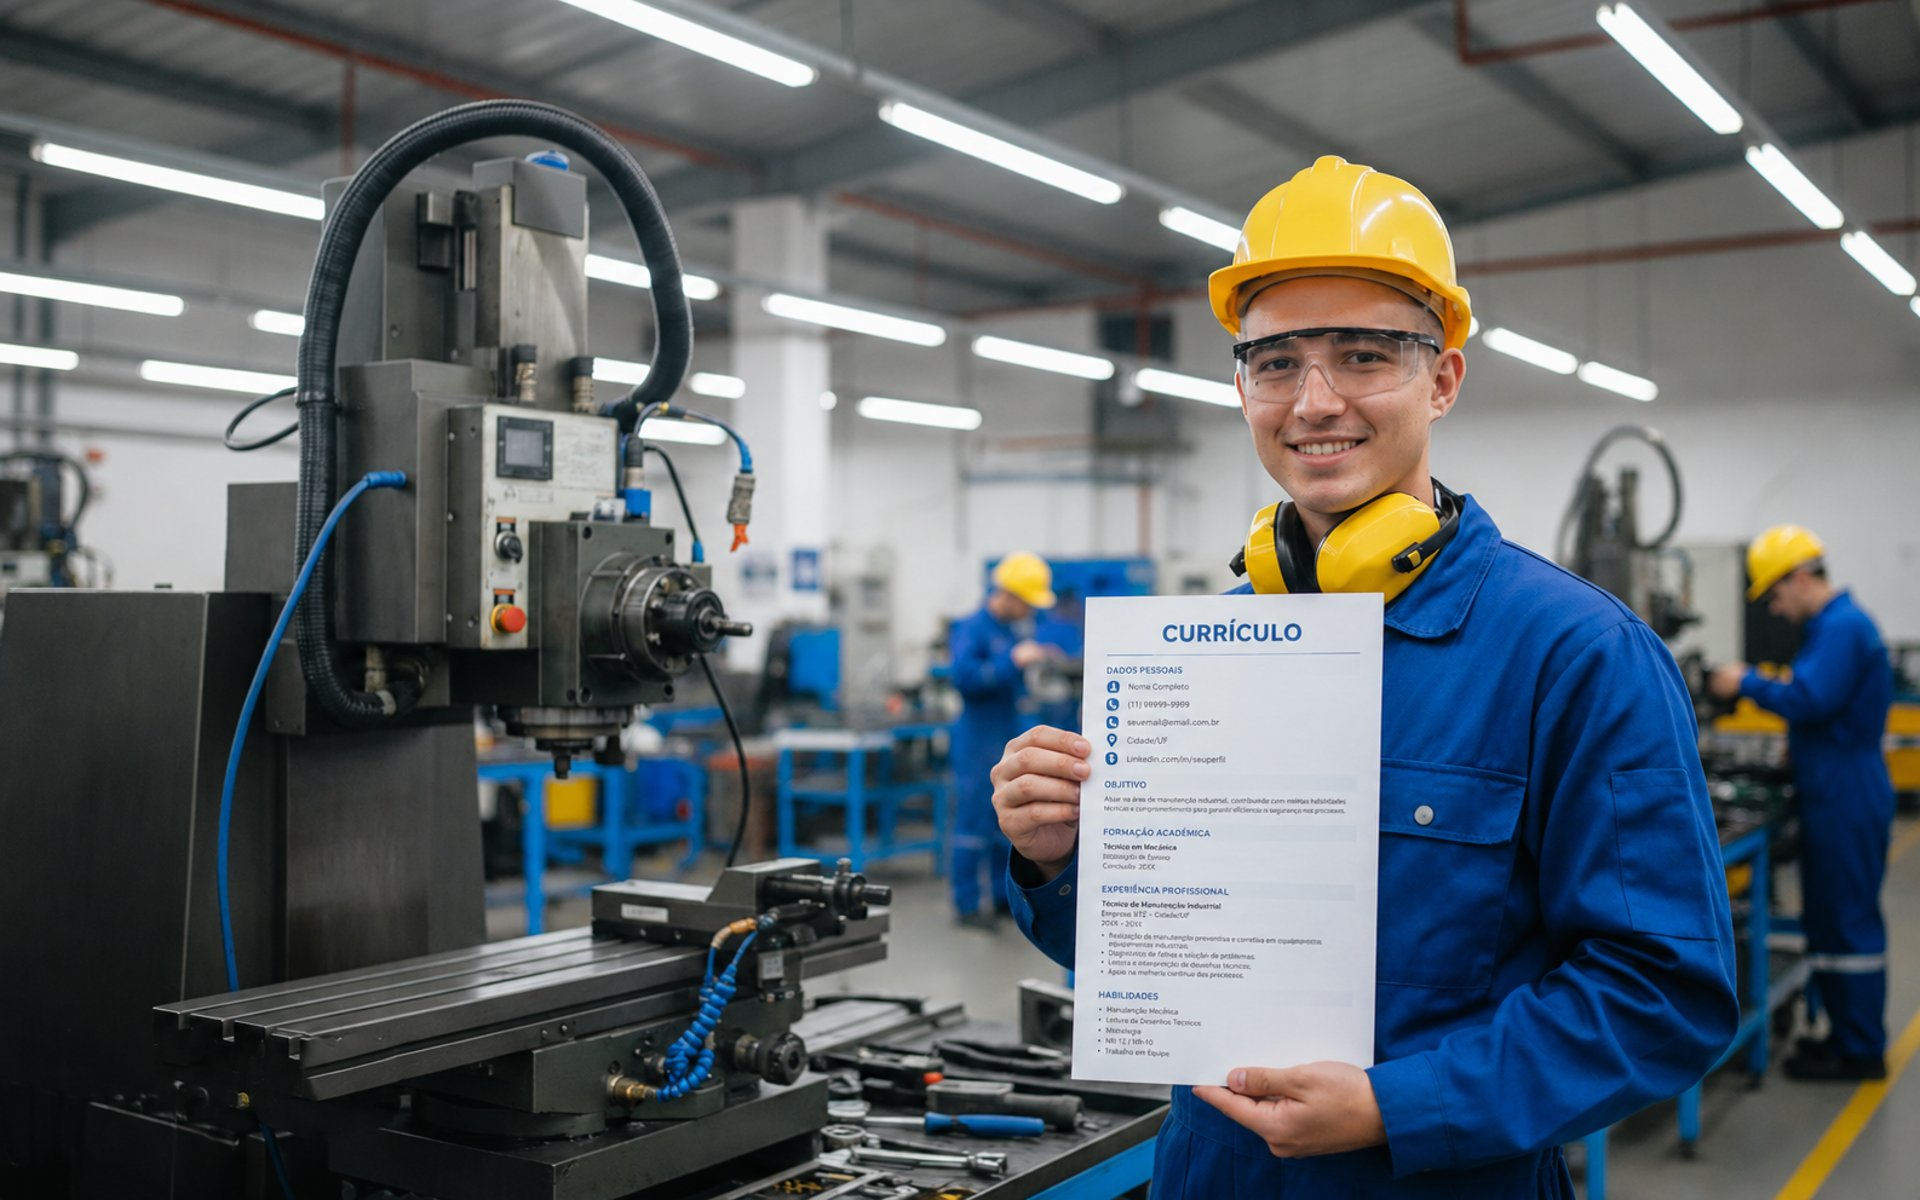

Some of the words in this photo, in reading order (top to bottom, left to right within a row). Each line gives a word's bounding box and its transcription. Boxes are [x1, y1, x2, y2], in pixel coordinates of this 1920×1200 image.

[1162, 619, 1302, 643] CURRÍCULO
[1106, 666, 1137, 675] DADOS
[1140, 666, 1183, 675] PESSOAIS
[1128, 683, 1151, 691] Nome
[1152, 682, 1190, 692] Completo
[1127, 700, 1142, 710] (11)
[1162, 886, 1230, 896] PROFISSIONAL
[1098, 991, 1159, 1001] HABILIDADES
